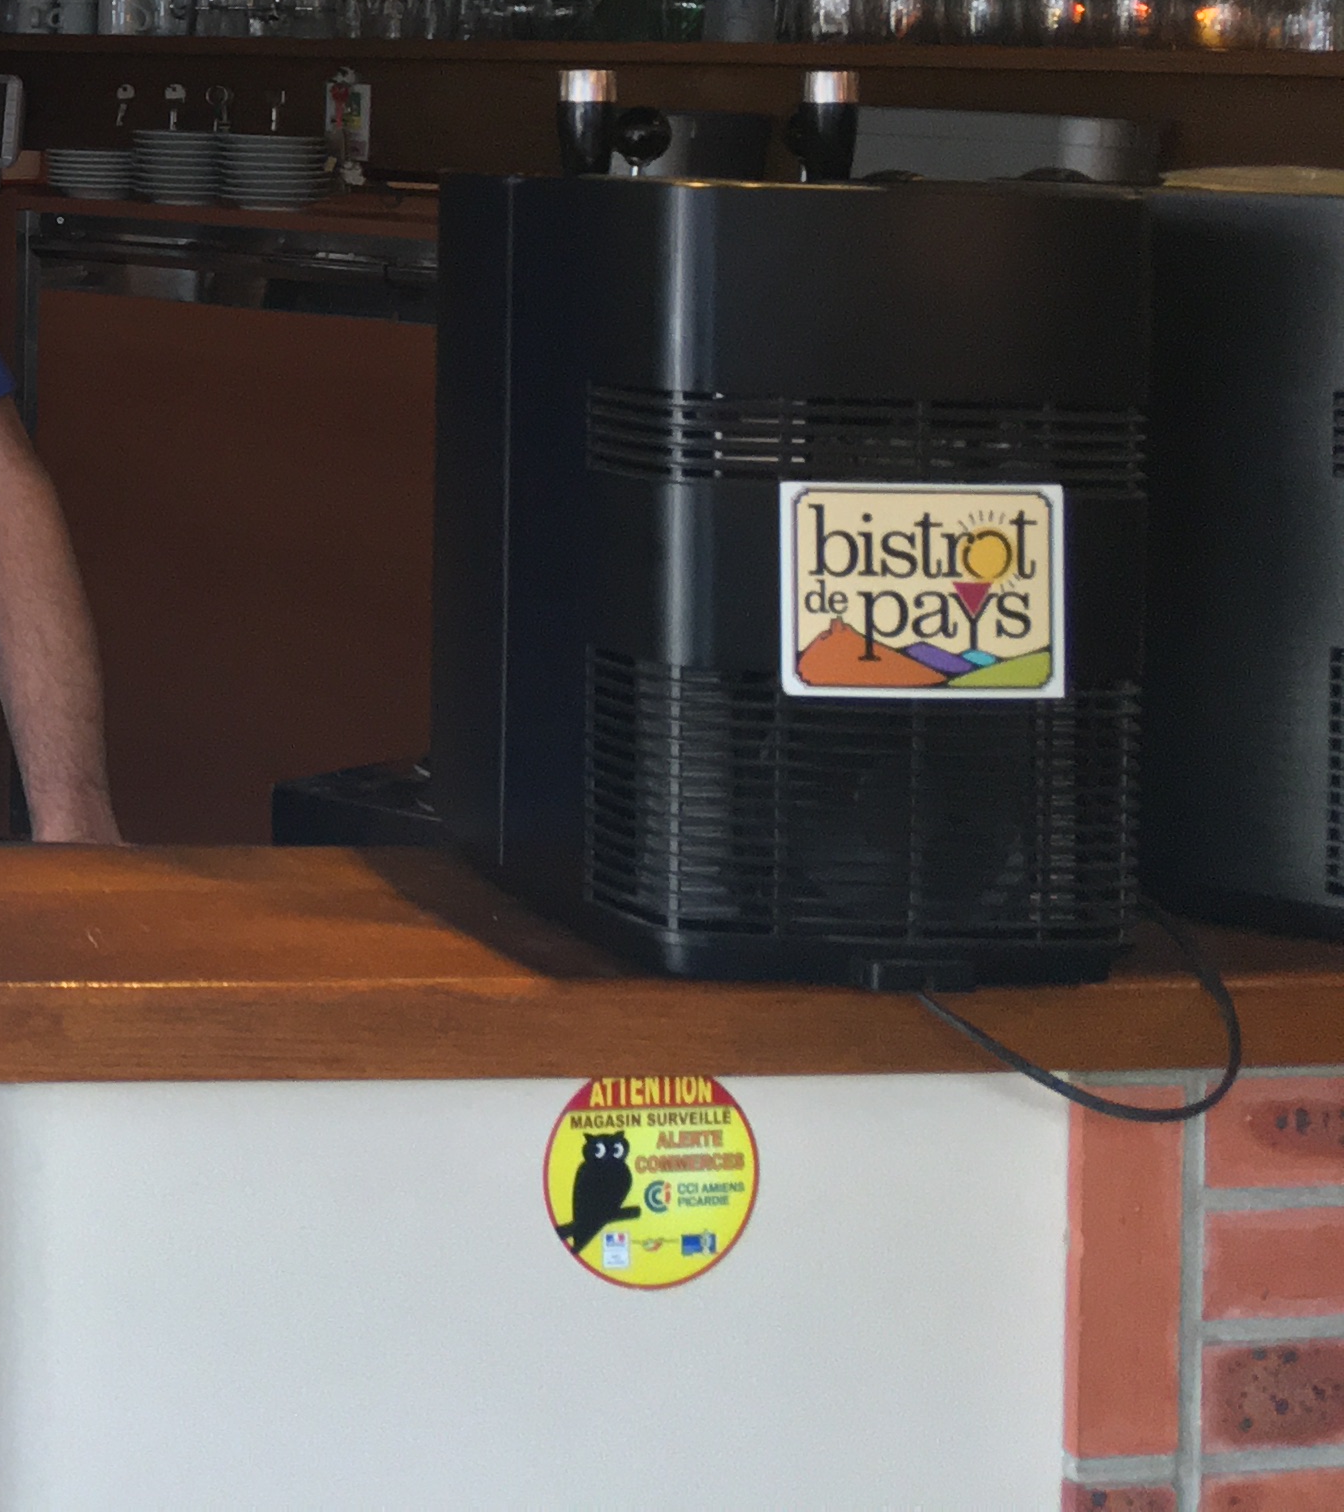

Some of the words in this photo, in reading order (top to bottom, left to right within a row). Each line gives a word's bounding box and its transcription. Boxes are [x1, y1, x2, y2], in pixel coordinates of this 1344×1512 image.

[807, 502, 1038, 580] bistrot
[804, 579, 849, 615] de
[857, 588, 1031, 662] pays
[589, 1076, 712, 1108] ATTENTION
[569, 1113, 642, 1130] MAGASIN
[656, 1129, 724, 1150] ALERTE
[634, 1152, 746, 1174] COMMERCES
[677, 1182, 702, 1195] CCI
[703, 1180, 746, 1194] AMIENS
[677, 1194, 730, 1208] PICARDIE
